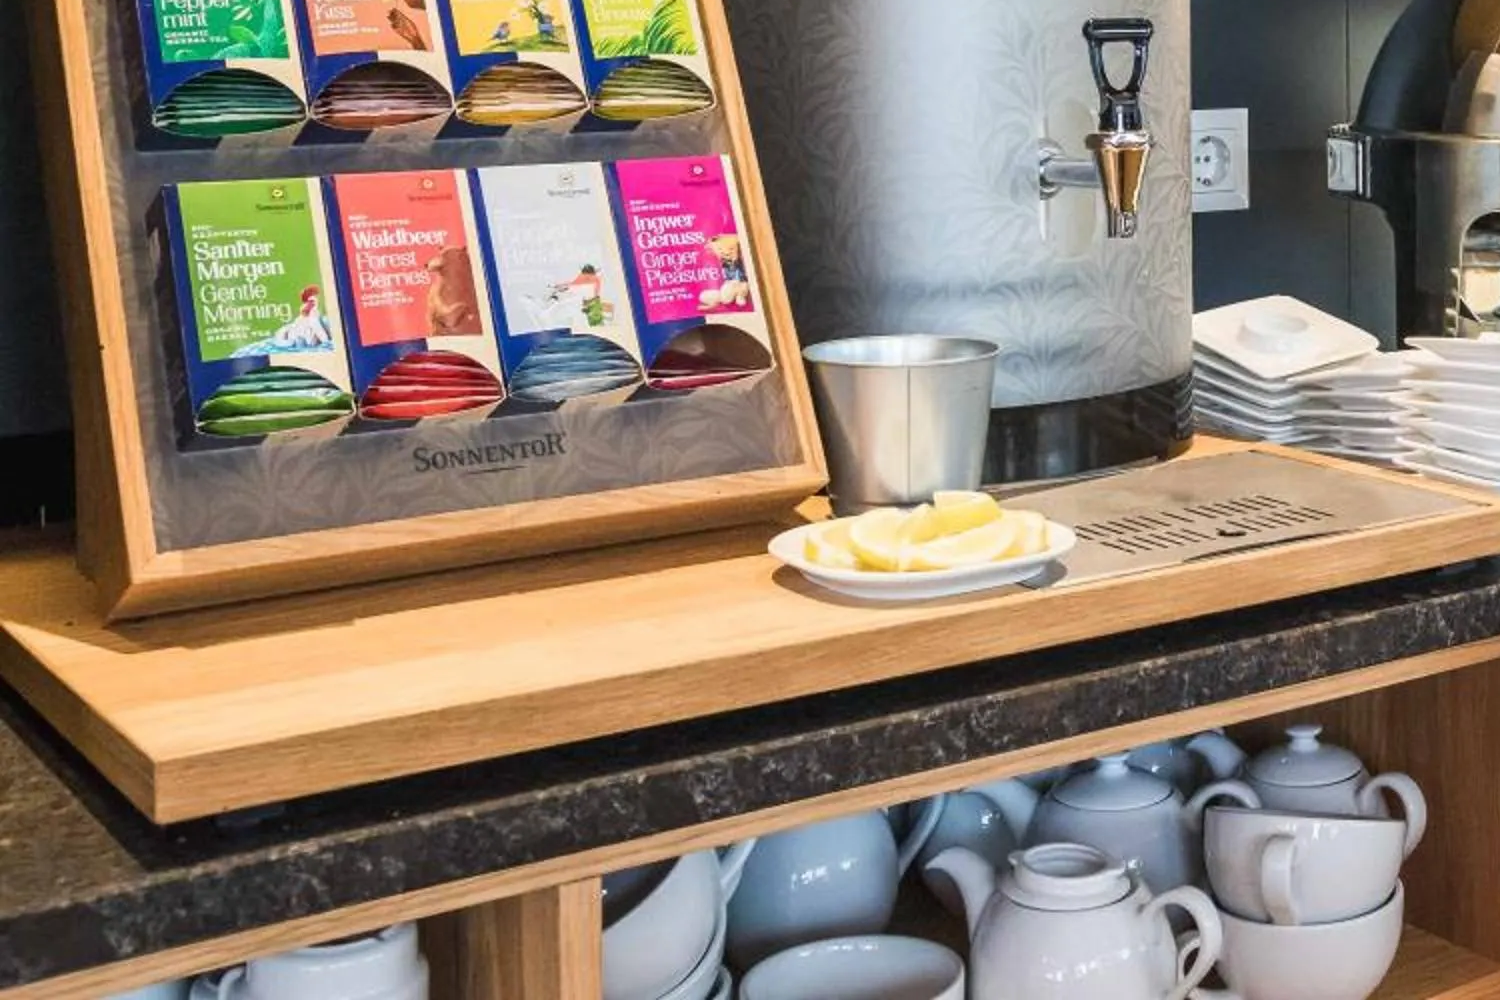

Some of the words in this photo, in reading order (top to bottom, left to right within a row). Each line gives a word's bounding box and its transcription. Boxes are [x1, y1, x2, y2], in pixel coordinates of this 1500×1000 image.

[163, 9, 208, 29] mint
[633, 213, 697, 234] Ingwer
[351, 228, 448, 250] Waldbeer
[636, 230, 705, 249] Genuss
[192, 239, 275, 262] Sanfter
[355, 250, 418, 271] Forest
[640, 250, 700, 272] Ginger
[196, 259, 286, 283] Morgen
[358, 269, 432, 290] Berries
[645, 267, 720, 288] Pleasure
[201, 281, 268, 304] Gentle
[203, 300, 293, 325] Morning
[412, 432, 567, 473] SONNENTOR
